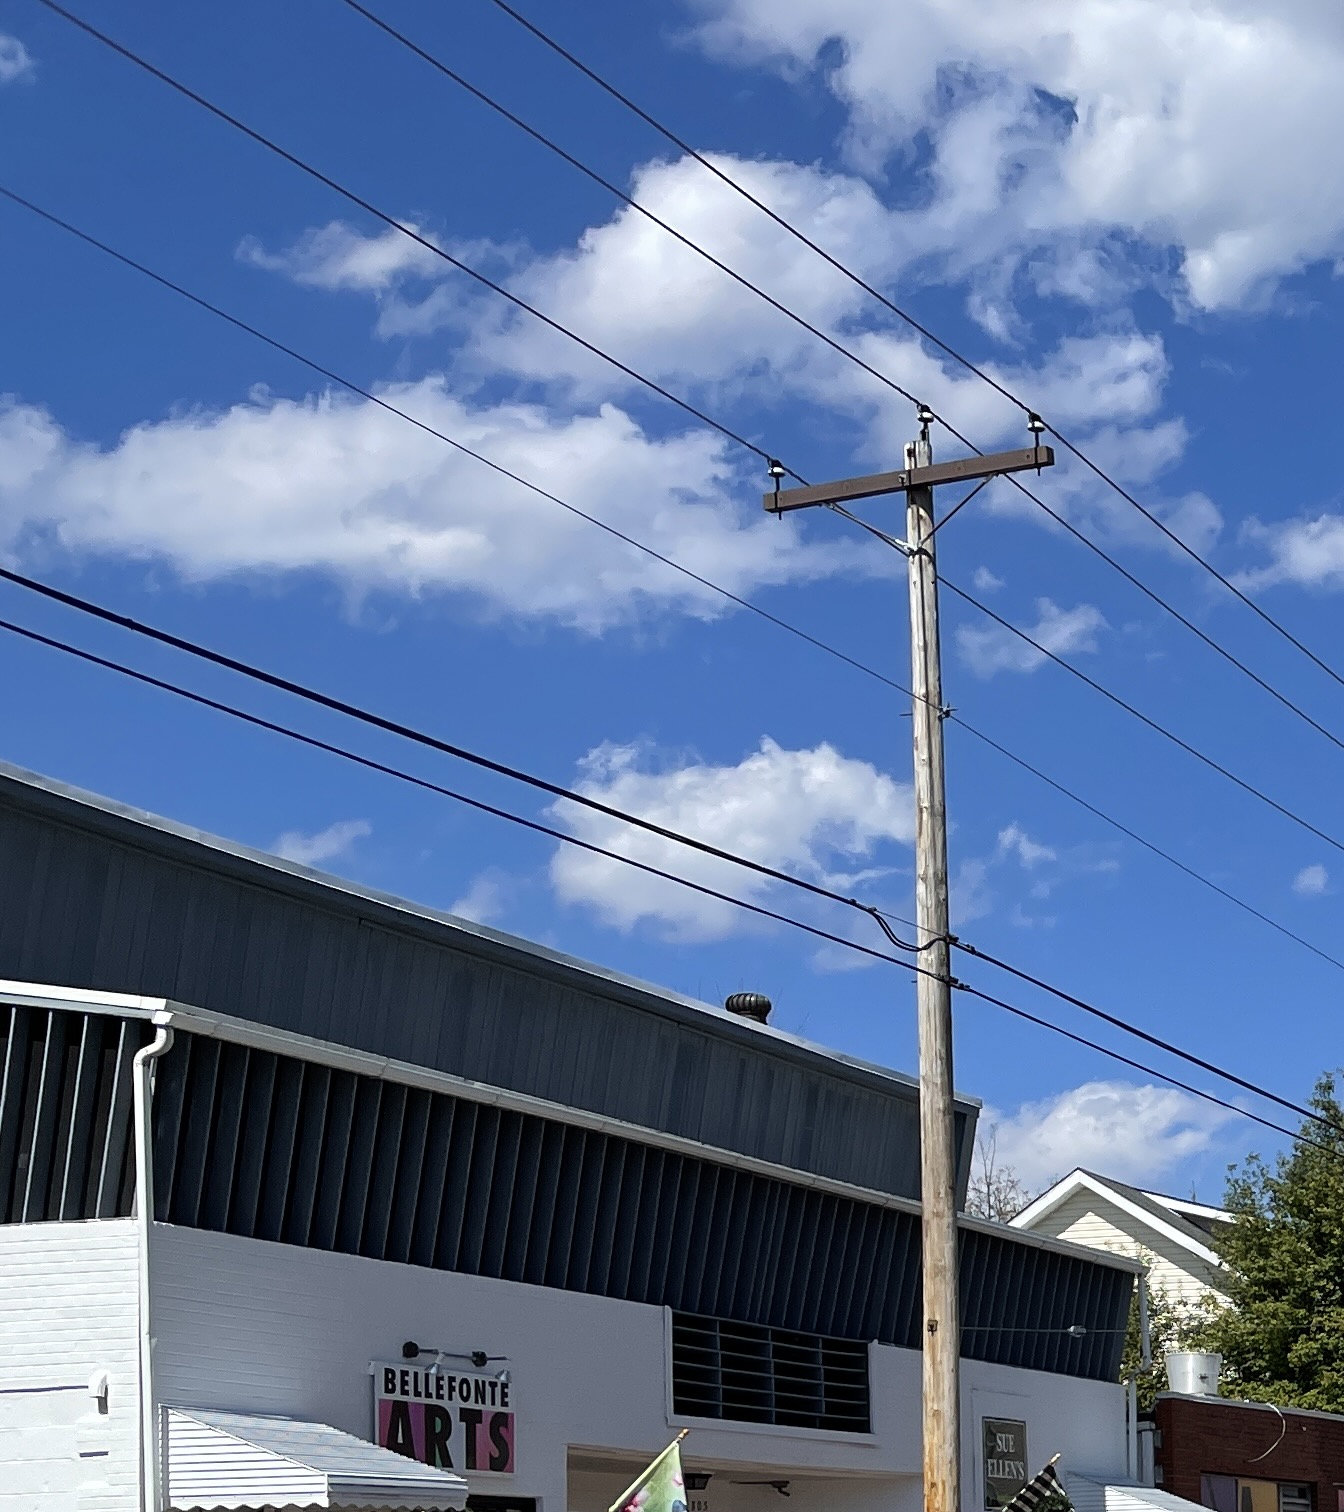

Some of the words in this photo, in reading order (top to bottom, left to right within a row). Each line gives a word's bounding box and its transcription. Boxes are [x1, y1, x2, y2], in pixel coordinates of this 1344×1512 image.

[383, 1367, 510, 1408] BELLEFONTE
[385, 1400, 510, 1473] ARTS
[996, 1432, 1016, 1453] SUE
